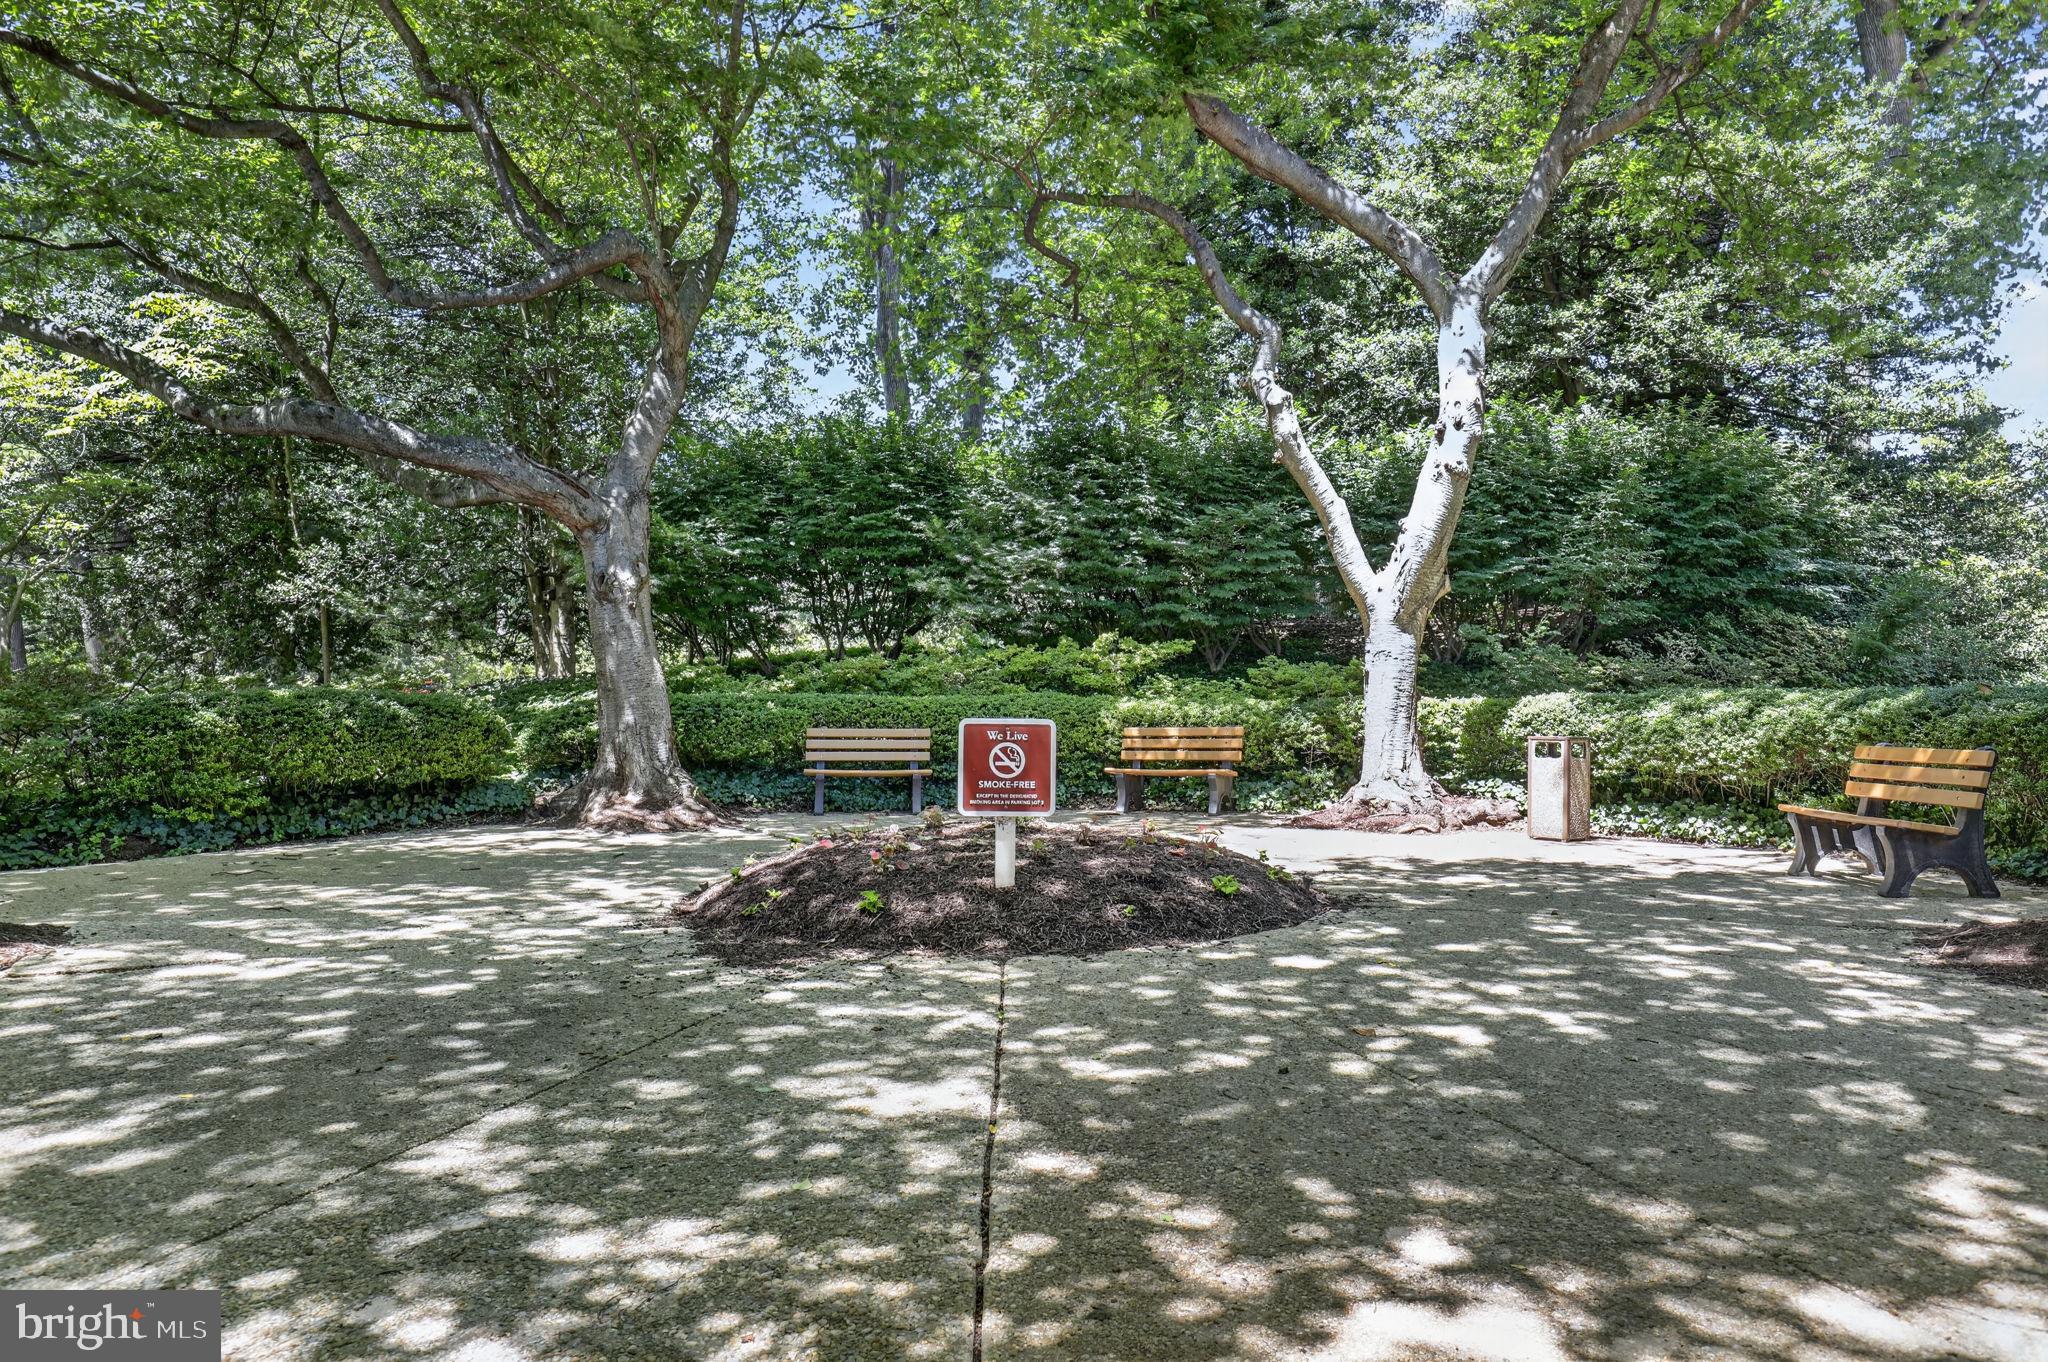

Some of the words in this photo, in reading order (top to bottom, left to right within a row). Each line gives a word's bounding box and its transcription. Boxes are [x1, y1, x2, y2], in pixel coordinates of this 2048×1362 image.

[987, 731, 1003, 740] We
[1006, 731, 1028, 740] Live
[978, 780, 1036, 789] SMOKE-FREE
